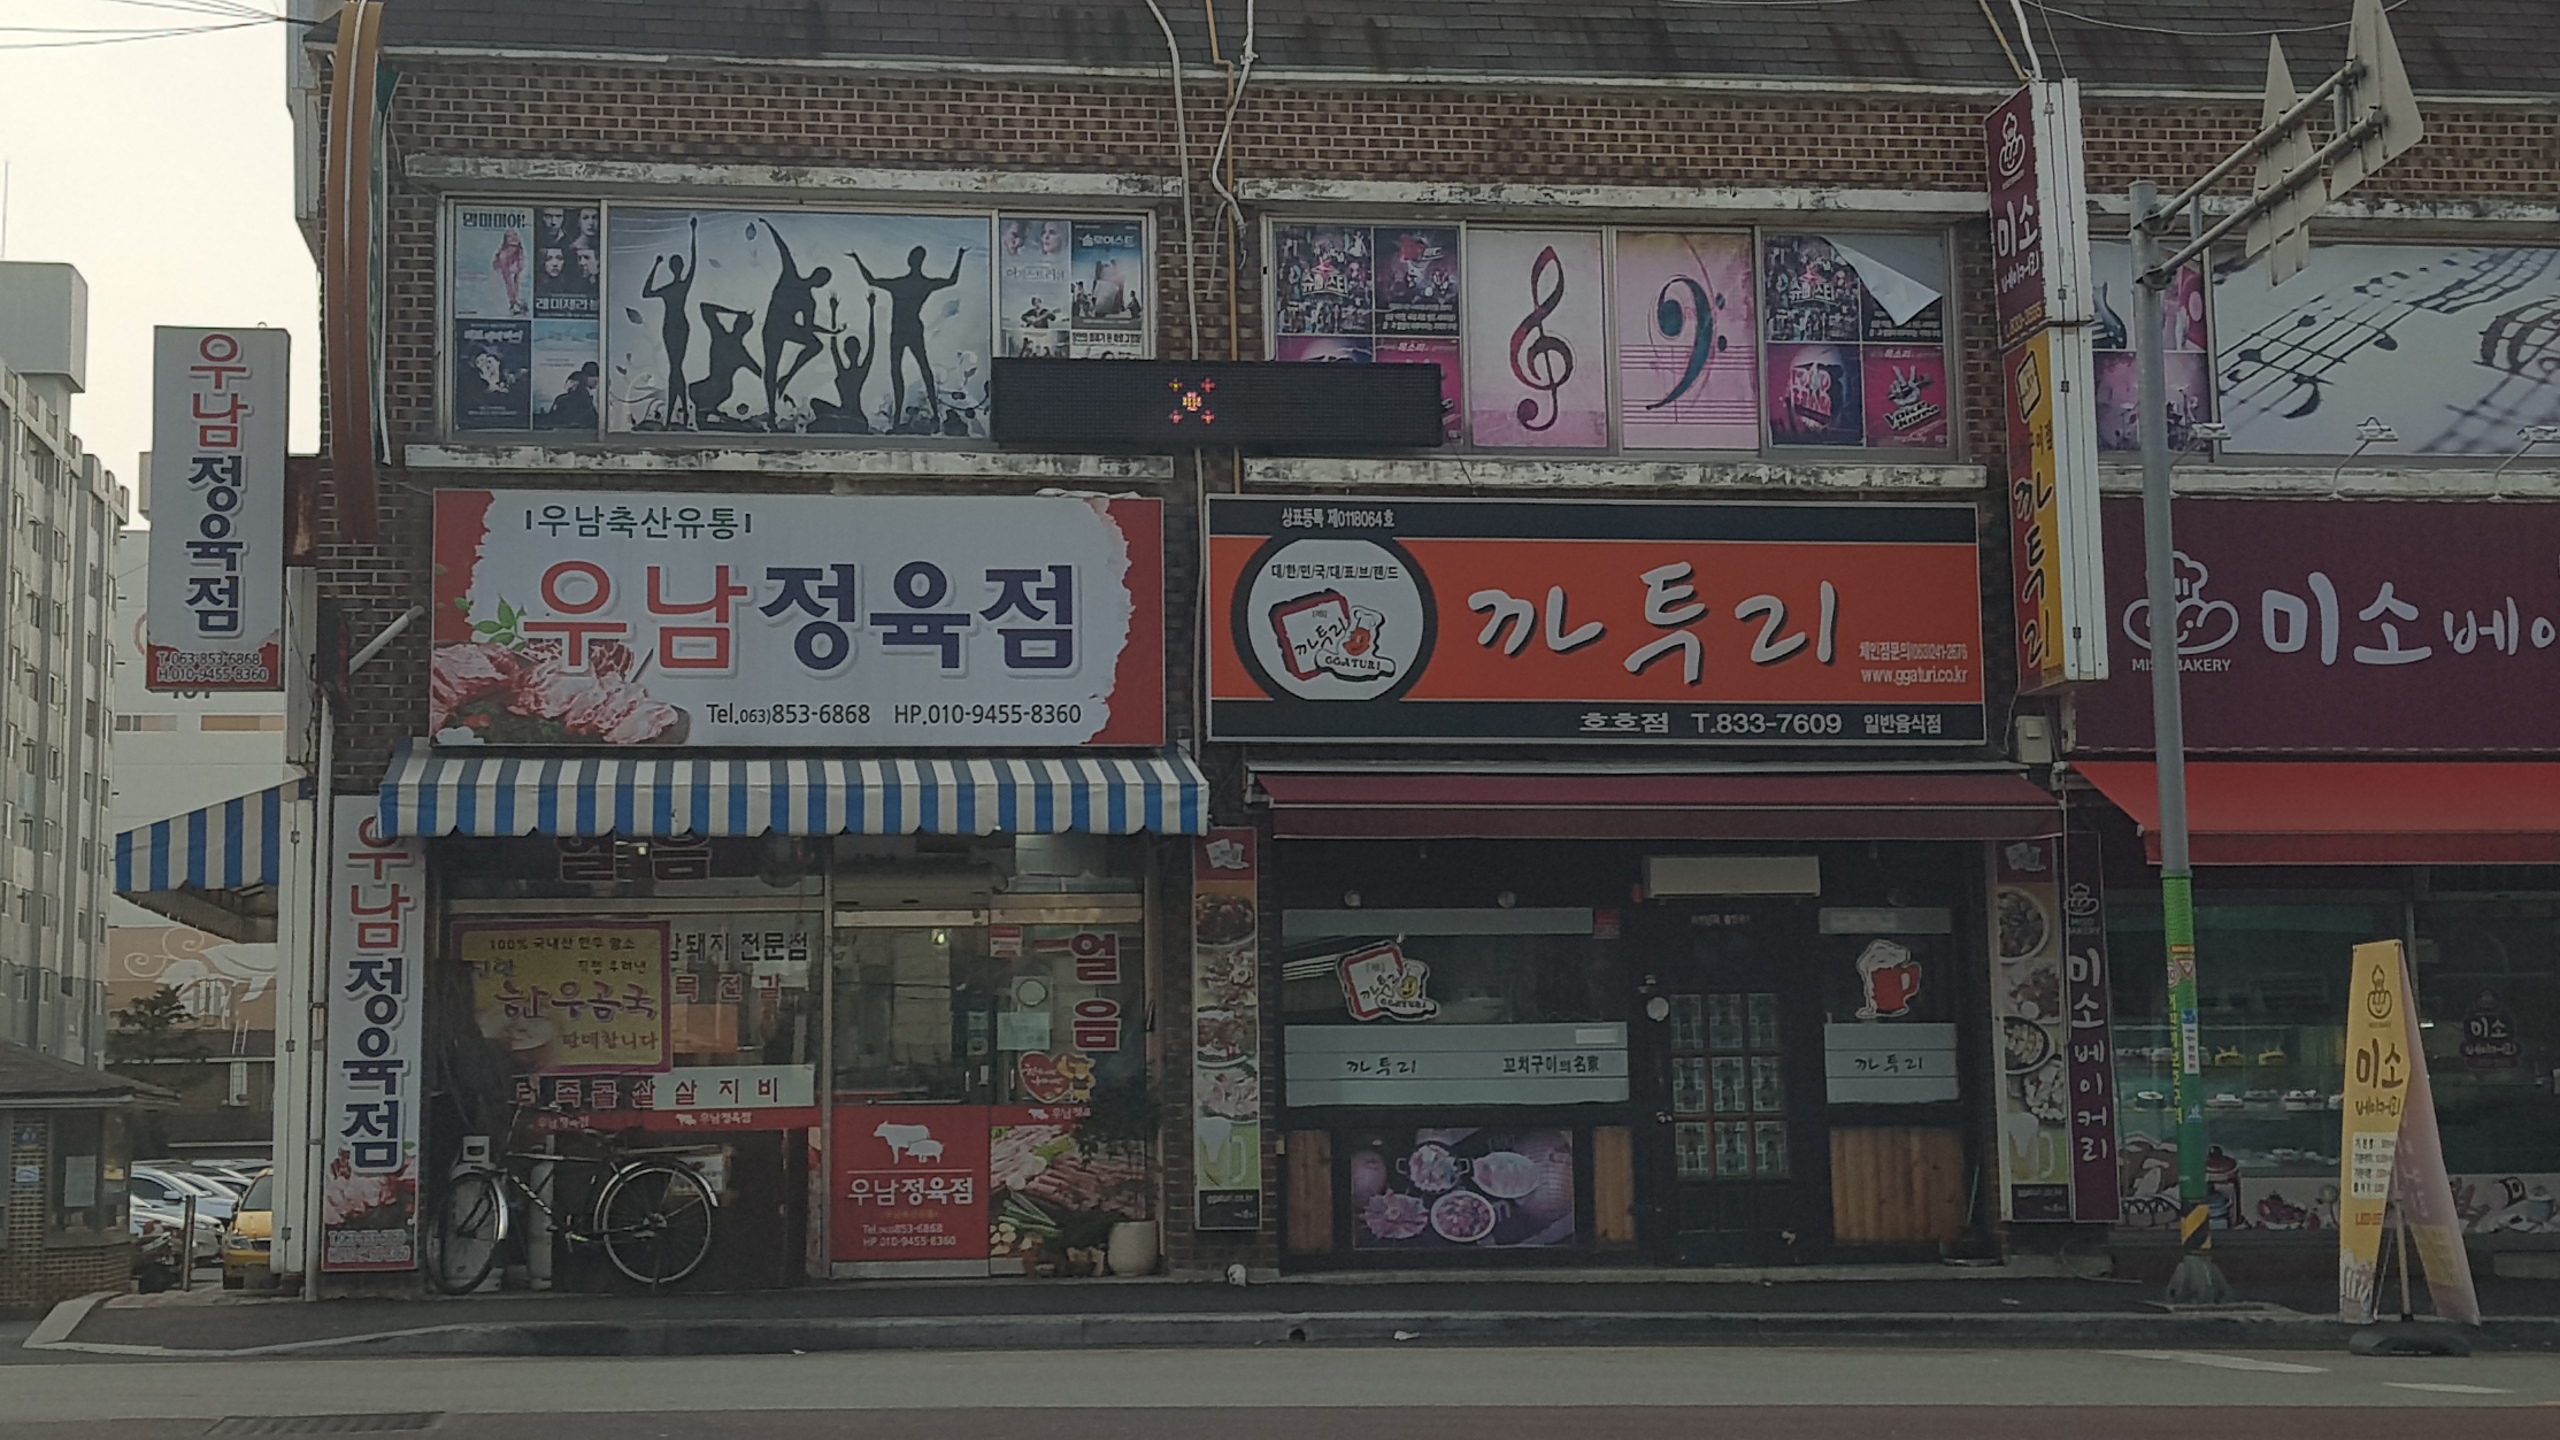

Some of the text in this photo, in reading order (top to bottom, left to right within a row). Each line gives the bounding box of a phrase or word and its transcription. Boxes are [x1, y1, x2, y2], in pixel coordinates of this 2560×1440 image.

[1998, 194, 2038, 257] 미소
[2001, 250, 2040, 293] 베이커리
[186, 334, 248, 633] 우남정육점
[1282, 508, 1323, 528] 상표등록
[2015, 472, 2053, 666] 까투리
[524, 560, 1077, 671] 우남정육점
[1467, 561, 1839, 686] 까투리
[2261, 571, 2433, 666] 미소
[1294, 618, 1349, 655] 까투리
[158, 652, 261, 666] T.063-853-6868
[1325, 655, 1382, 671] GGATURI
[158, 668, 267, 681] H.010-9455-8360
[1861, 665, 1969, 687] www.ggaturi.co.kr
[706, 703, 1082, 727] Tel.063)853-6868 HP.010-9455-8360
[1579, 711, 1942, 735] 호호점 T.833-7609 일반음식점
[490, 938, 529, 951] 100%
[532, 937, 574, 951] 국내산
[741, 932, 808, 962] 전문점
[341, 815, 410, 1168] 우남정육점
[495, 980, 657, 1021] 한우곰국
[2071, 948, 2105, 1031] 미소
[561, 1031, 659, 1051] 판매합니다
[2470, 1016, 2509, 1039] 미소
[1346, 1058, 1418, 1076] 까투리
[1854, 1057, 1923, 1072] 까투리
[2356, 1038, 2404, 1089] 미소
[2075, 1040, 2109, 1162] 베이커리
[700, 1111, 754, 1124] 우남정육점
[846, 1177, 974, 1207] 우남정육점
